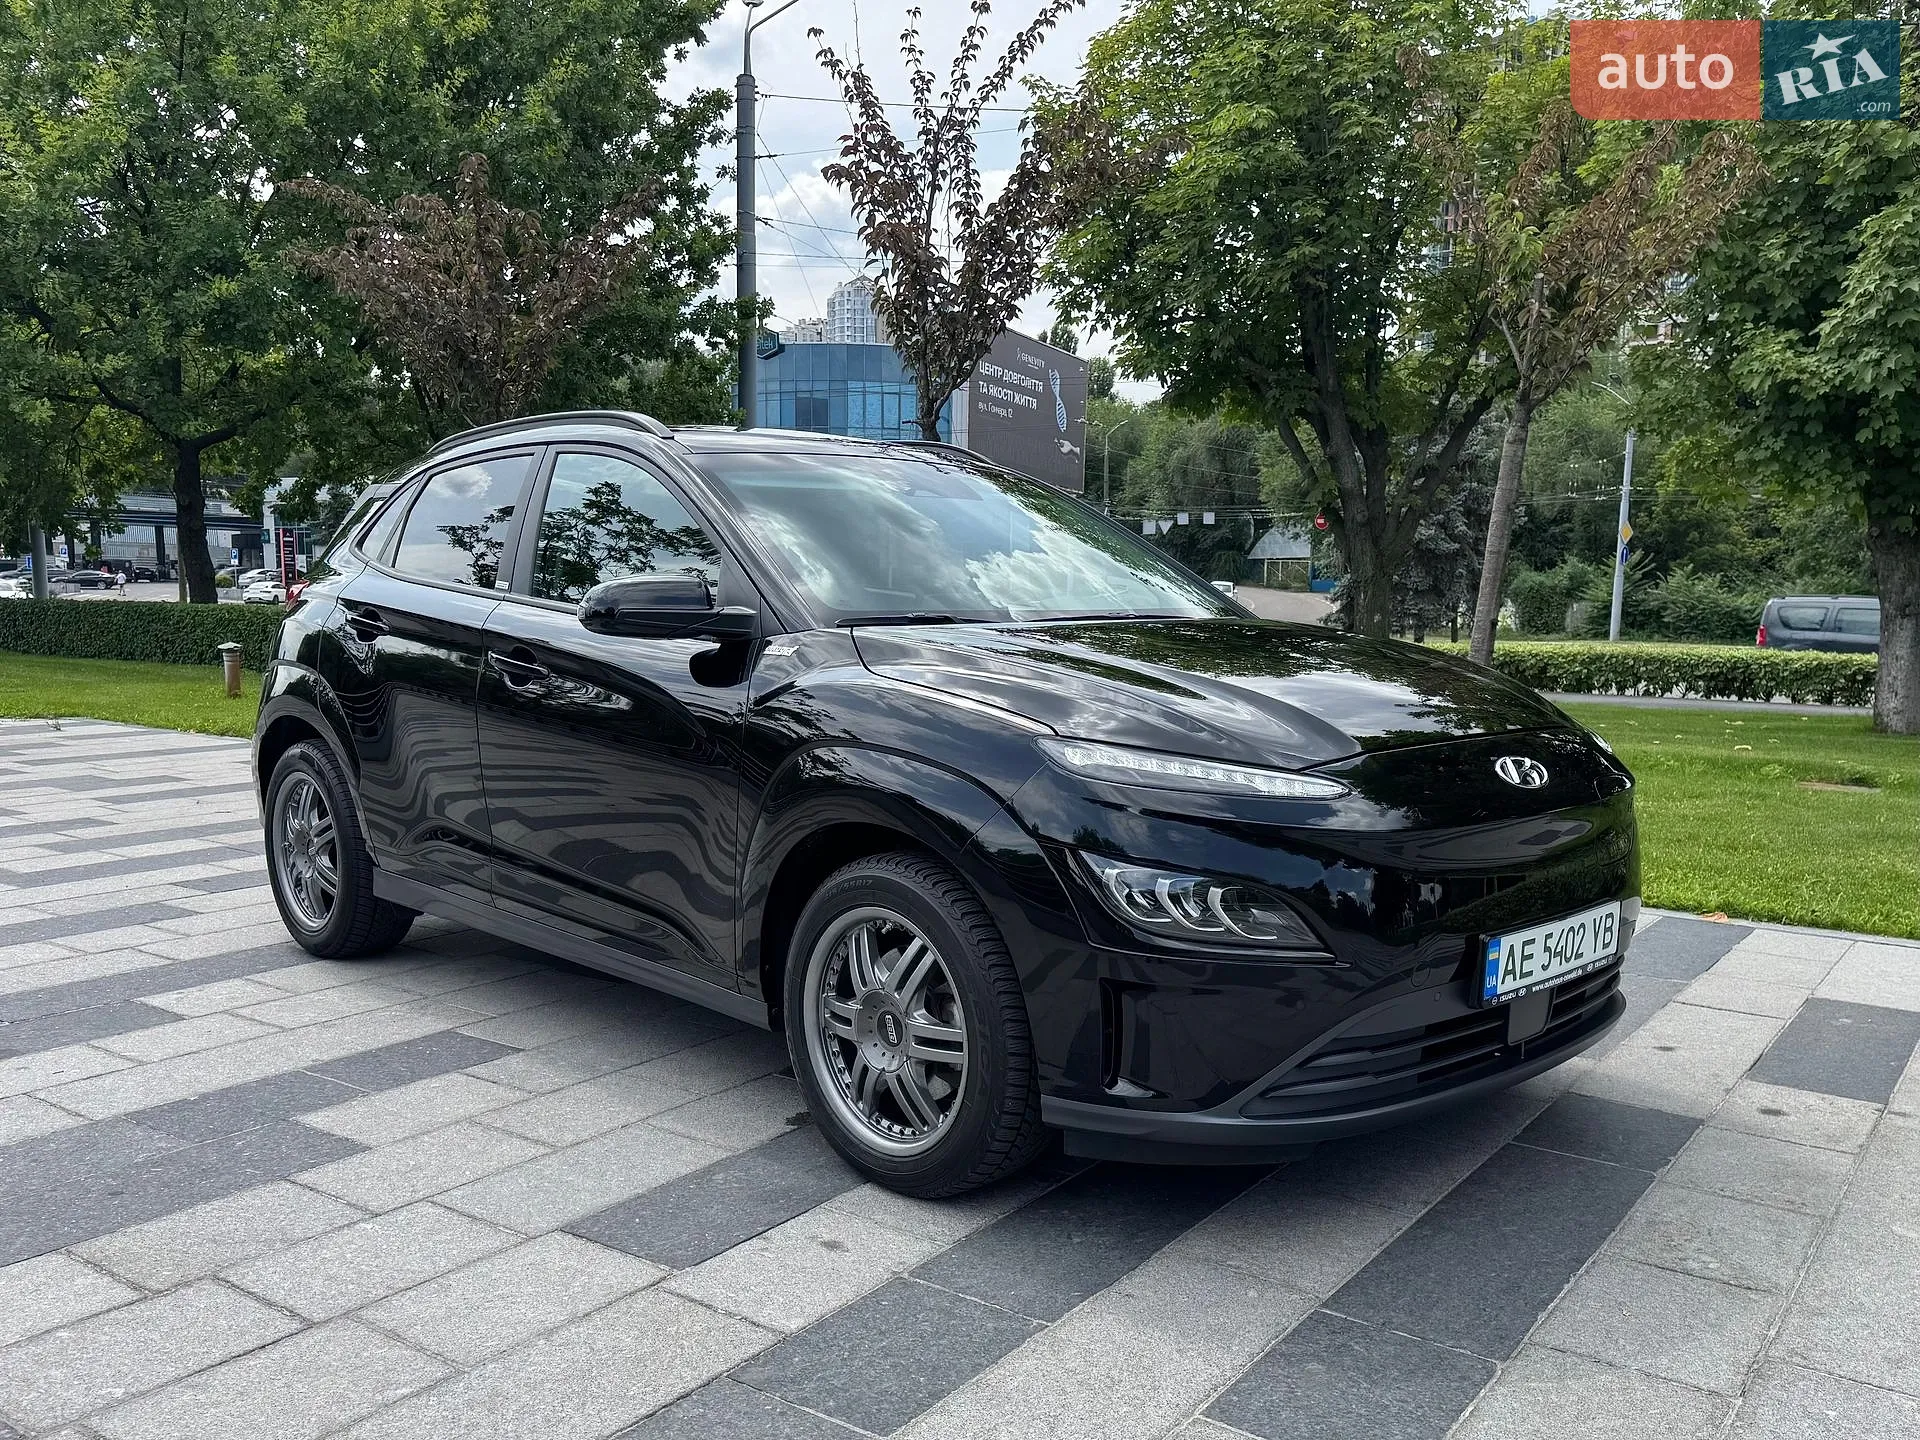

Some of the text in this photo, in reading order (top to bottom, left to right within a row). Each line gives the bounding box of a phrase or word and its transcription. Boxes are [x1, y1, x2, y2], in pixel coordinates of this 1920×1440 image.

[979, 360, 1043, 393] ЦЕНТР ДОВГОЛІТТЯ
[978, 381, 1037, 410] ТА ЯКОСТІ ЖИТТЯ
[1501, 912, 1615, 985] AE 5402 YB
[1486, 975, 1497, 989] UA
